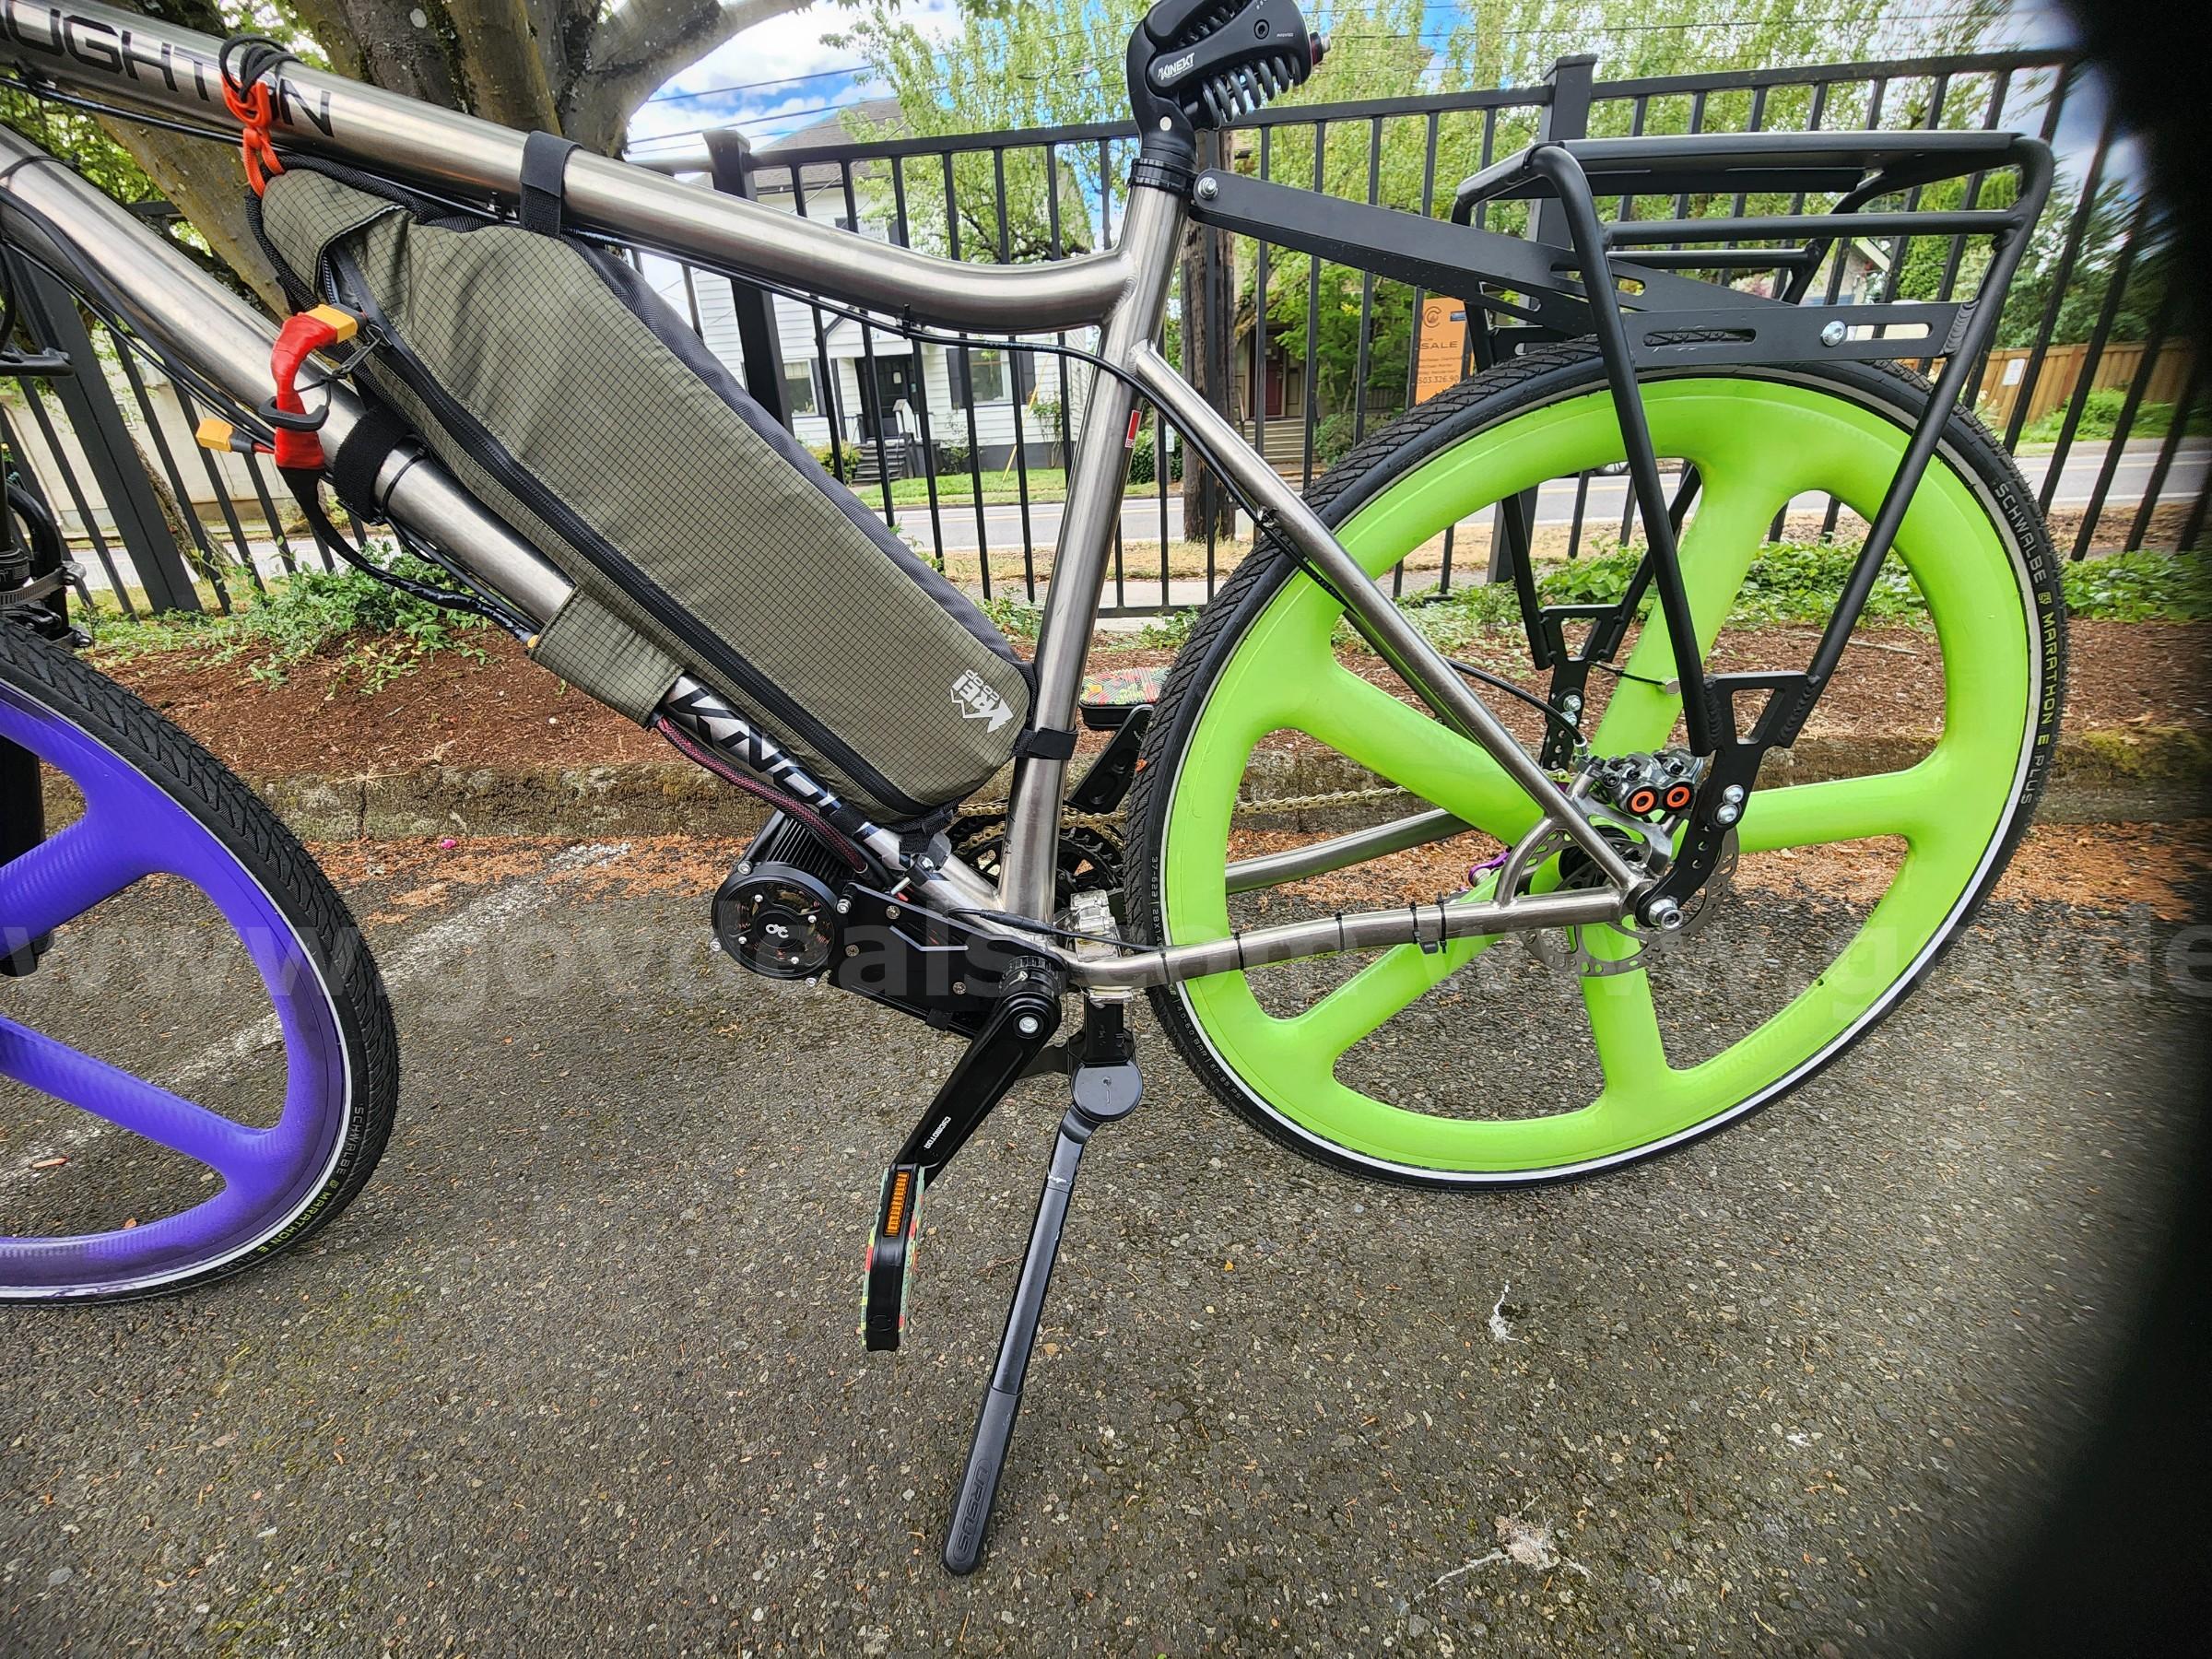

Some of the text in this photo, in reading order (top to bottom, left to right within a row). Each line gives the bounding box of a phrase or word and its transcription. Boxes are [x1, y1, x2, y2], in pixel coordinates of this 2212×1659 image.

[0, 0, 335, 137] UGHTN
[1158, 53, 1194, 80] KINEKT
[1421, 341, 1457, 349] SALE
[1994, 481, 2047, 584] SCHWALBE
[952, 675, 995, 712] REI
[2041, 611, 2059, 725] MARATHON
[667, 687, 922, 871] KNOL
[2019, 753, 2046, 805] PLUS
[1193, 1039, 1207, 1057] BAR
[1209, 1064, 1230, 1087] 60-85
[1230, 1088, 1244, 1101] PSI
[335, 1106, 365, 1176] SCHWALBE
[269, 1191, 333, 1252] MARATHON
[218, 1253, 257, 1273] PLUS
[958, 1465, 989, 1553] URSUS
